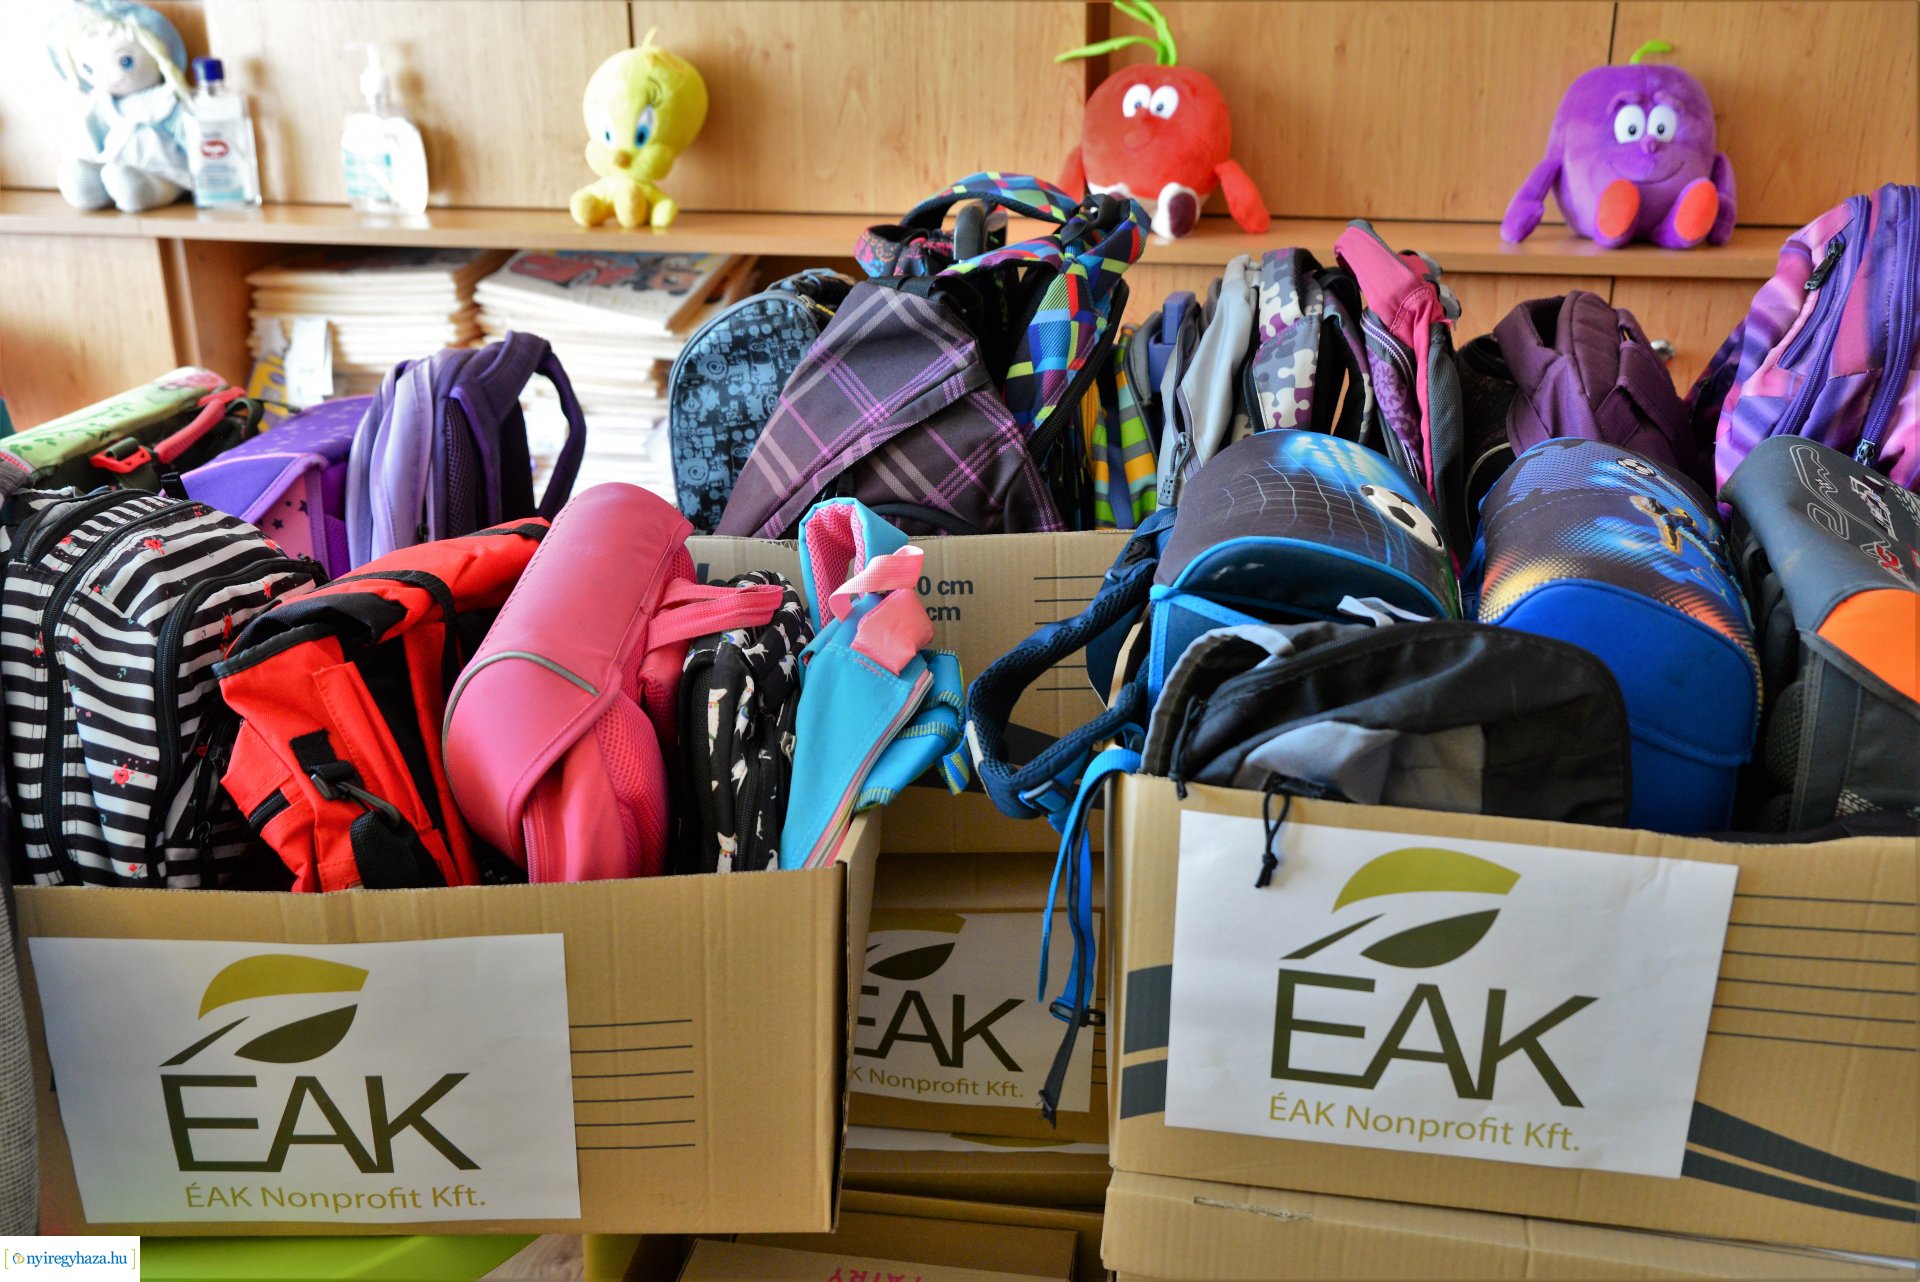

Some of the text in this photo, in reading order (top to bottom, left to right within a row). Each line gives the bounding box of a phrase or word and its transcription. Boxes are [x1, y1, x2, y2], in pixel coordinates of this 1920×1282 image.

[937, 579, 974, 596] cm
[869, 1067, 980, 1096] Nonprofit
[986, 1080, 1024, 1098] Kft.
[1269, 1092, 1580, 1151] ÉAK Nonprofit Kft.
[185, 1182, 486, 1213] ÉAK Nonprofit Kft.
